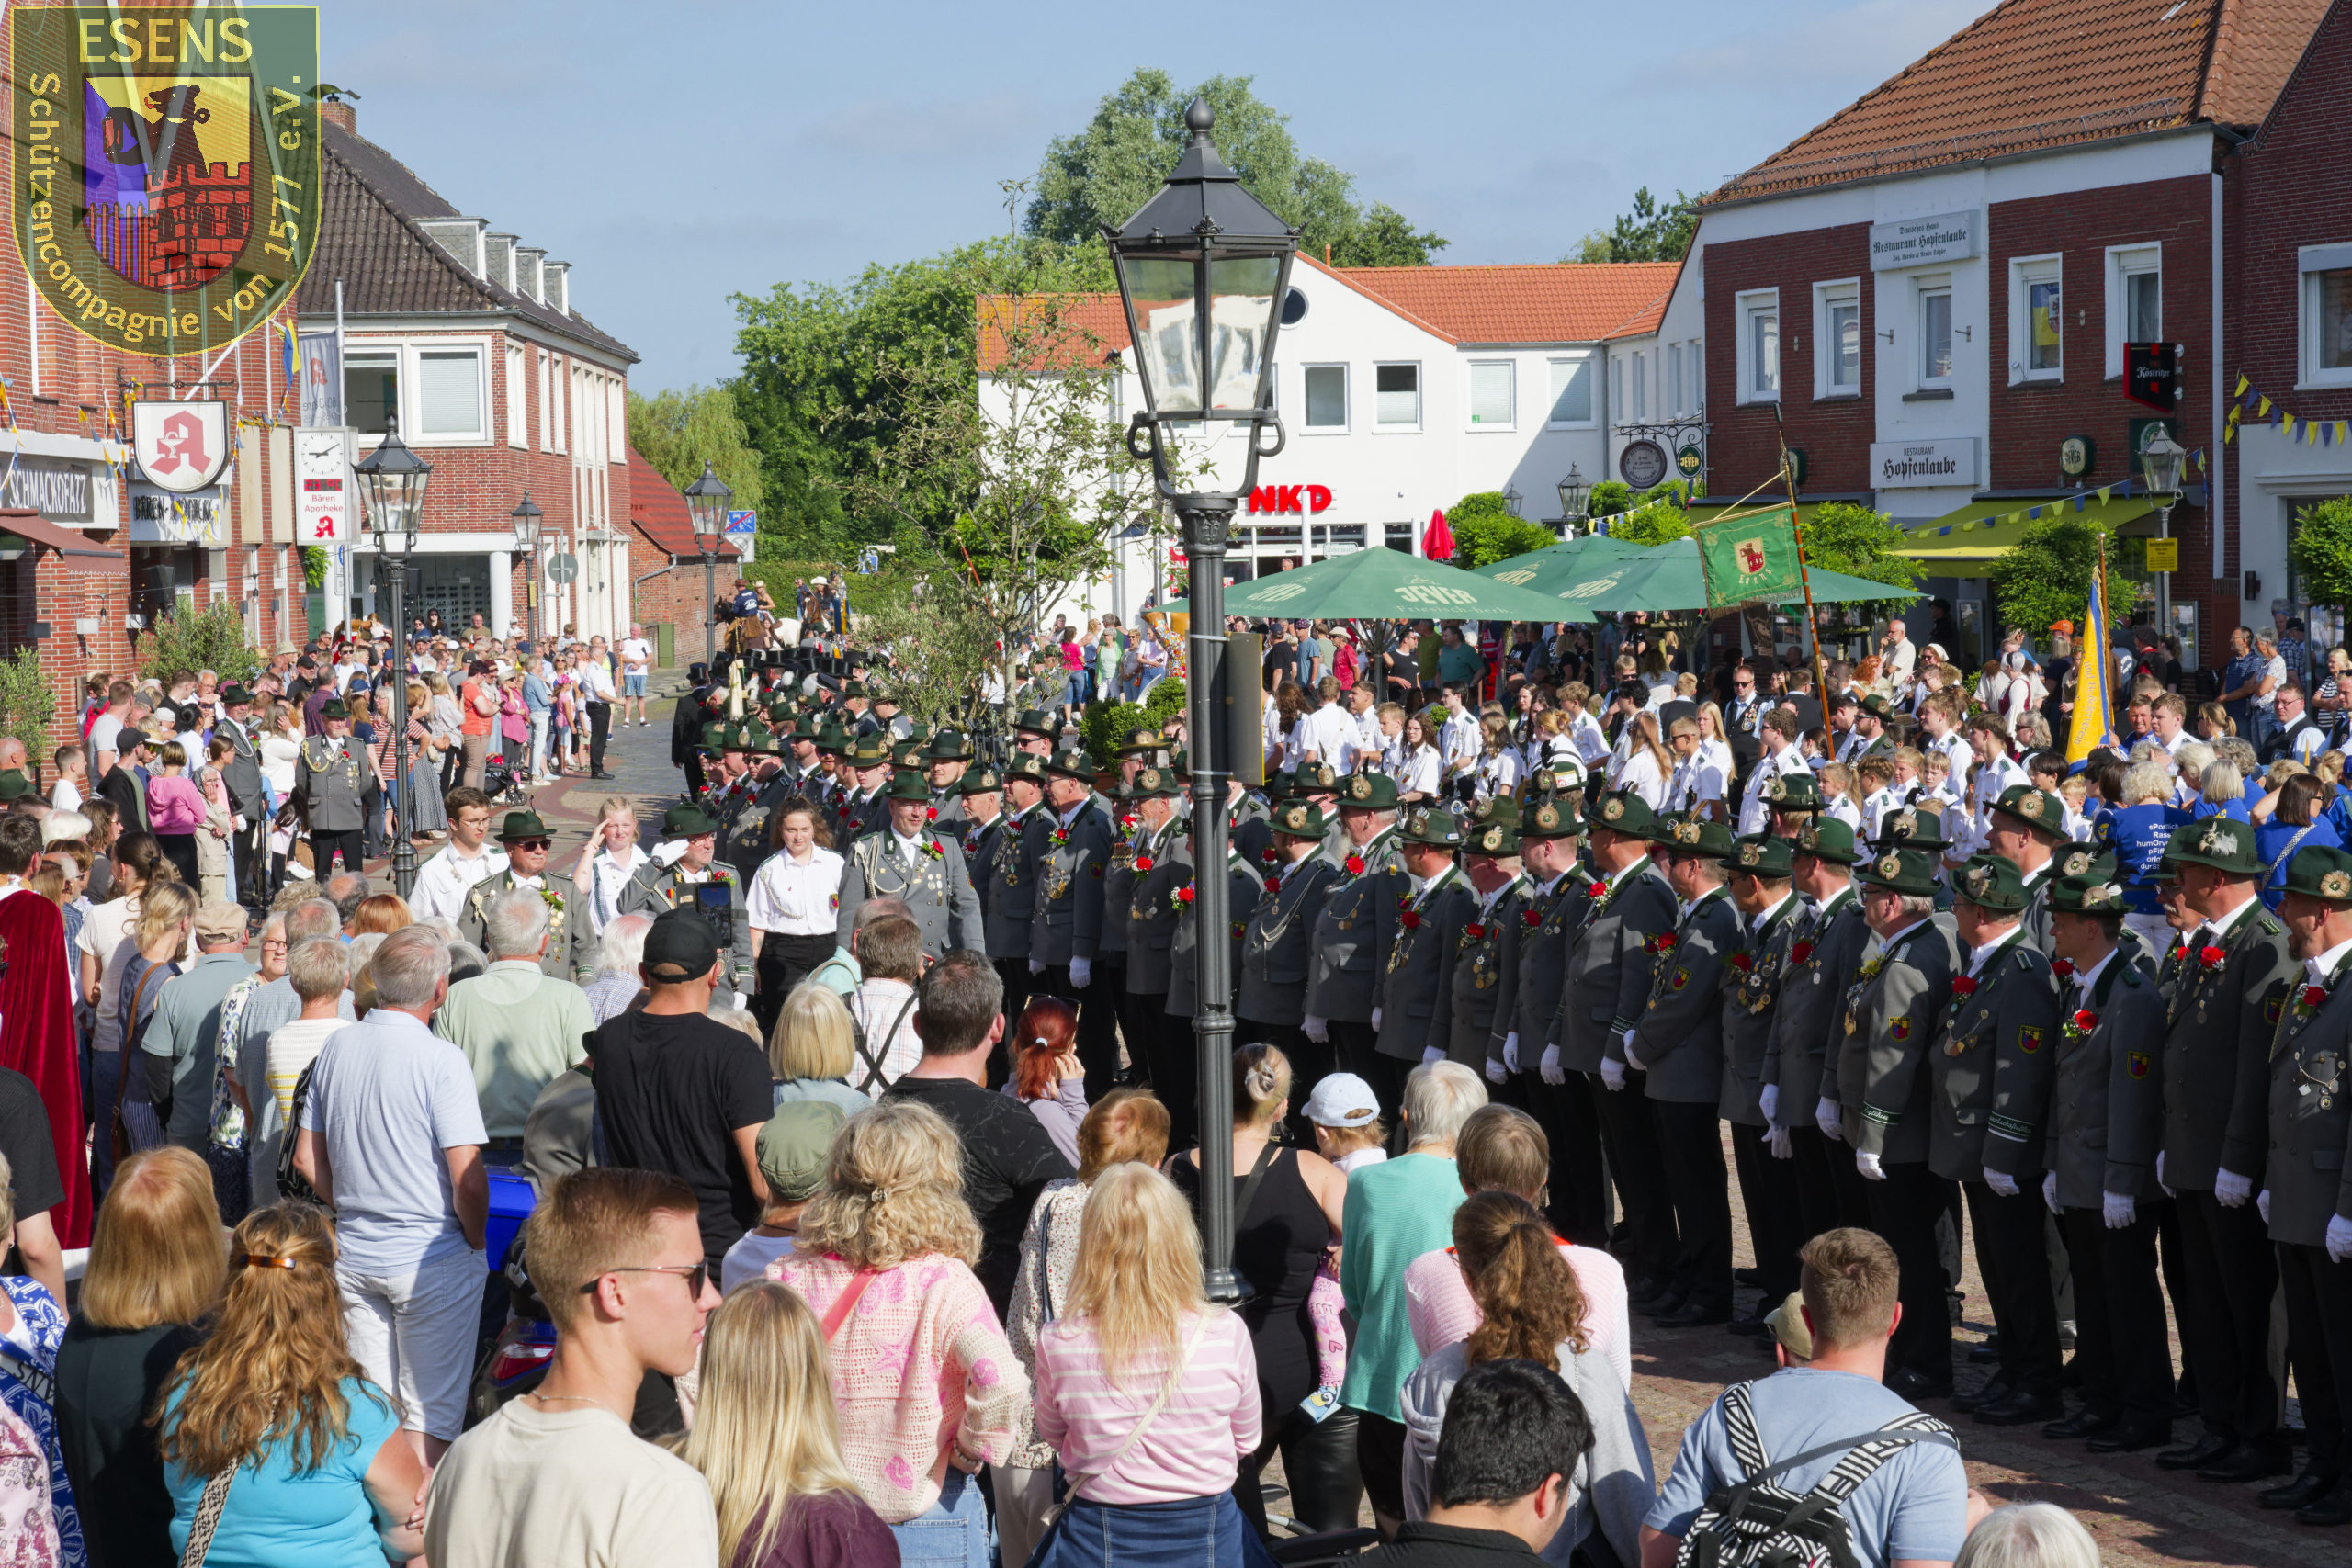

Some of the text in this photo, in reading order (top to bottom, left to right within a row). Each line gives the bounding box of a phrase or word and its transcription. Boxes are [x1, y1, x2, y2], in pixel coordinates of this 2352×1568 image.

[1872, 237, 1917, 254] Restaurant
[2136, 367, 2171, 379] Köstritzer
[1904, 446, 1935, 457] RESTAURANT
[1679, 456, 1700, 468] JEVER
[1883, 456, 1956, 480] Hopfenlaube
[304, 479, 320, 491] 23
[10, 469, 86, 514] SCHMACKOFATZ
[311, 494, 335, 502] Bären
[1249, 484, 1332, 513] NKD
[304, 504, 344, 513] Apotheke
[1394, 585, 1477, 604] JEVER
